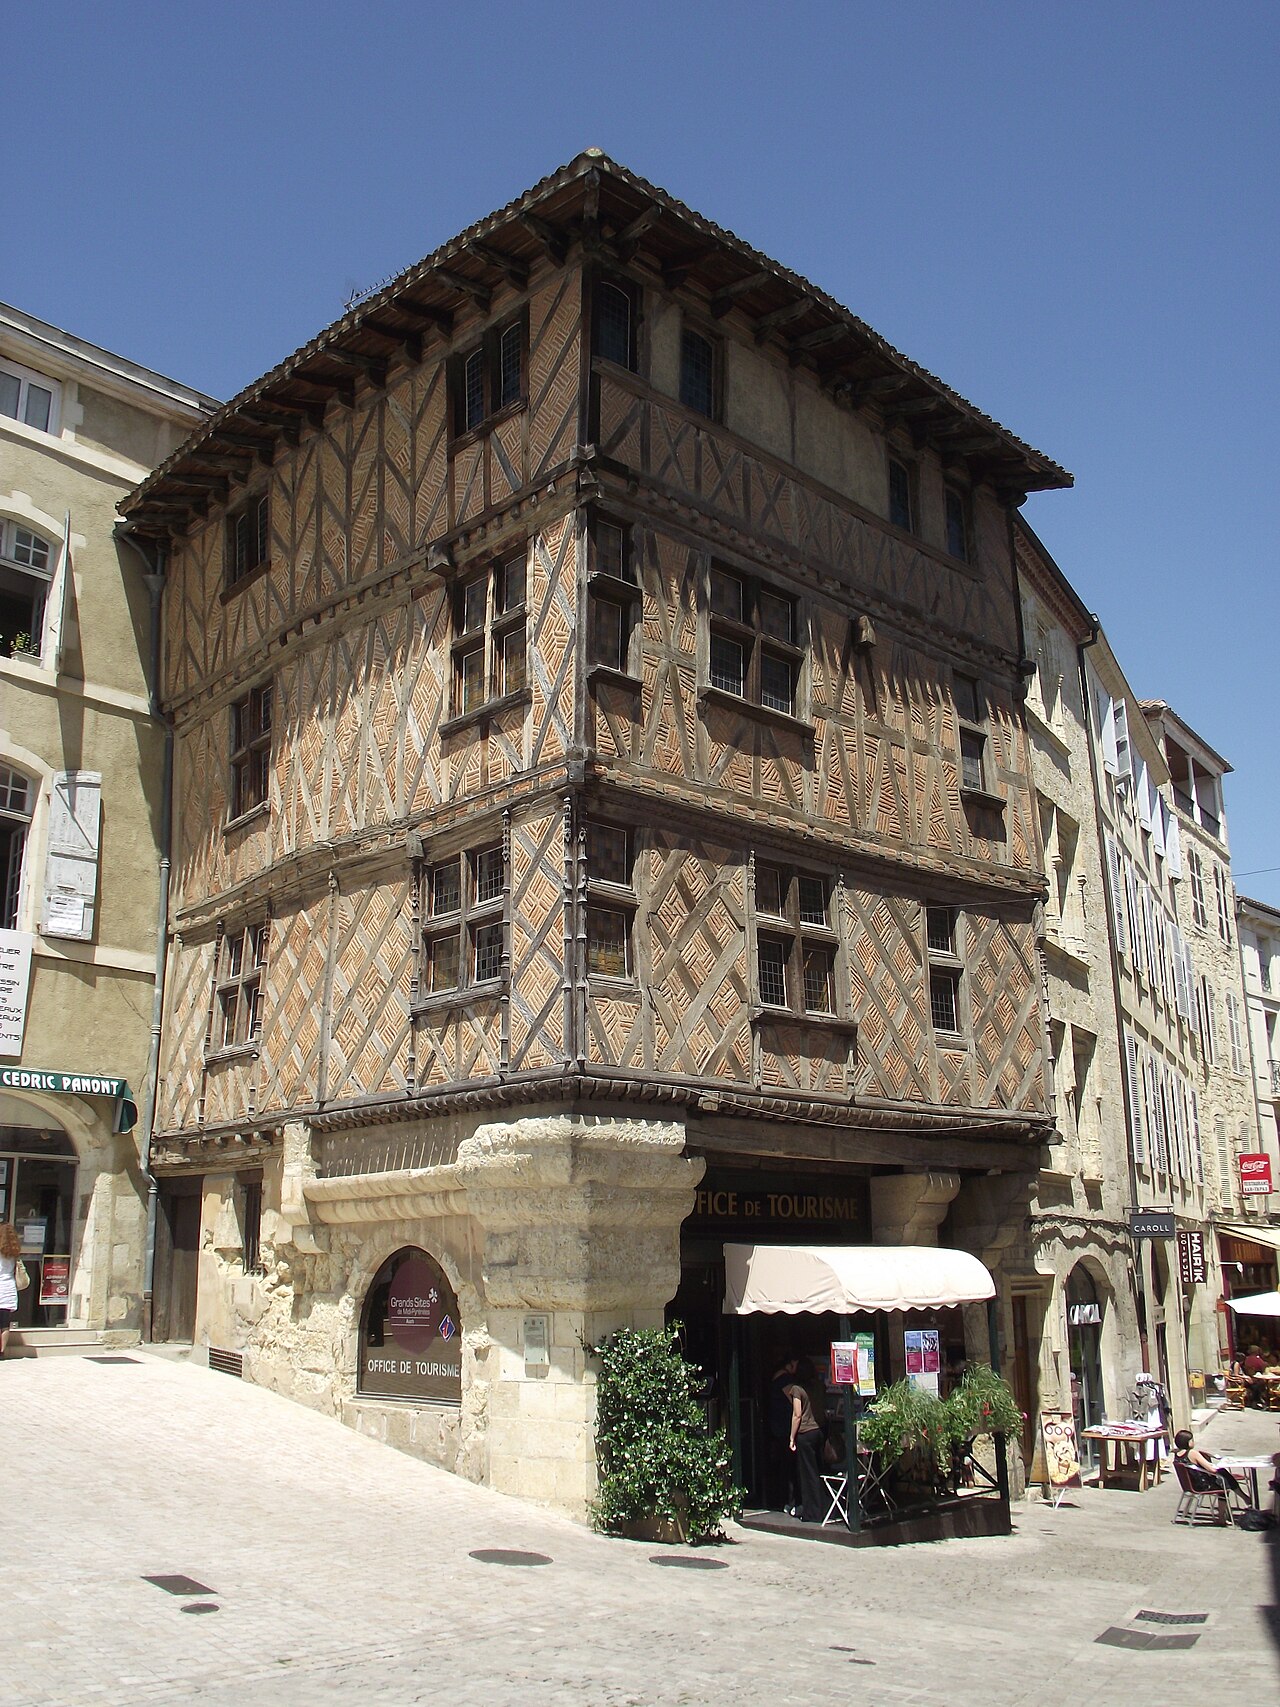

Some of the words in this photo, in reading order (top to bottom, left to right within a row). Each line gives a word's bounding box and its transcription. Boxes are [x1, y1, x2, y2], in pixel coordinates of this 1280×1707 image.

[2, 1071, 56, 1090] CEDRIC
[62, 1076, 119, 1095] PANONT
[696, 1190, 738, 1216] FICE
[744, 1200, 761, 1216] DE
[767, 1194, 858, 1220] TOURISME
[1133, 1224, 1170, 1232] CAROLL
[391, 1296, 414, 1308] Grands
[414, 1296, 431, 1308] Sites
[367, 1359, 396, 1374] OFFICE
[400, 1360, 412, 1374] DE
[415, 1361, 460, 1378] TOURISME
